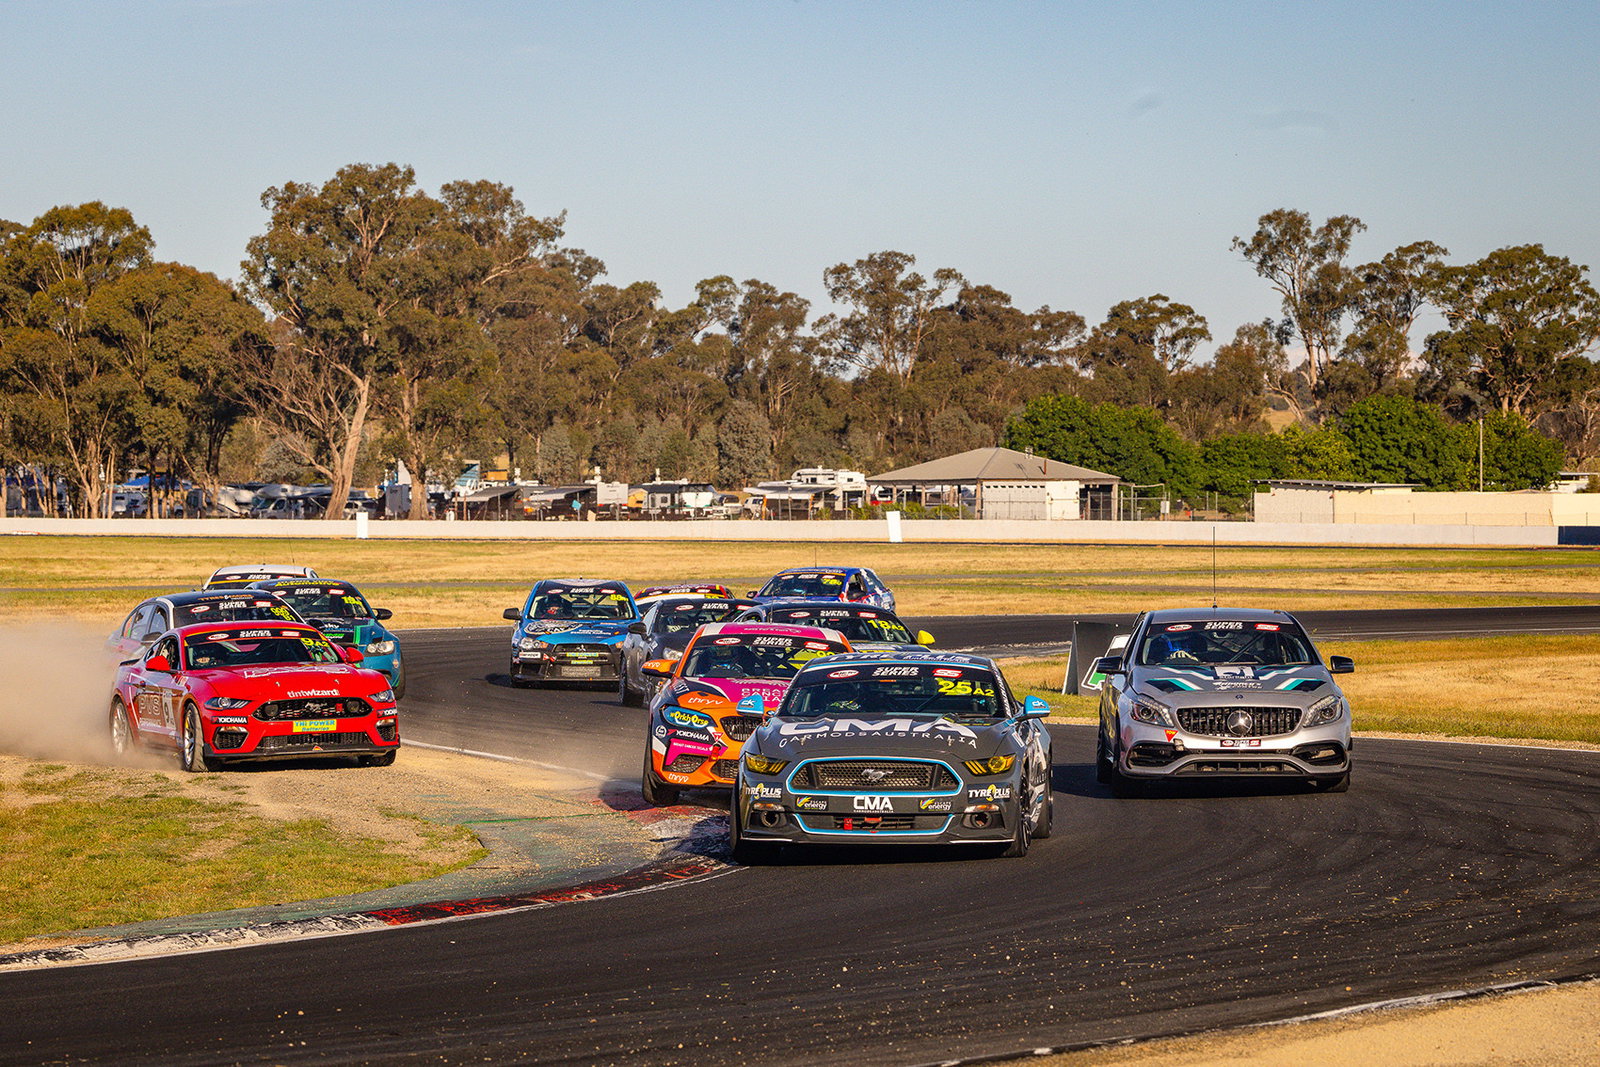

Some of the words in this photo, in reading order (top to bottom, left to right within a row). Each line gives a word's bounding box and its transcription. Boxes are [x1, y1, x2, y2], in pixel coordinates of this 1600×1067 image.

[937, 680, 973, 695] 25
[973, 687, 995, 697] A2
[779, 717, 978, 739] CMA
[676, 730, 709, 742] YOKOHAMA
[804, 803, 827, 811] energy
[853, 796, 894, 811] CMA
